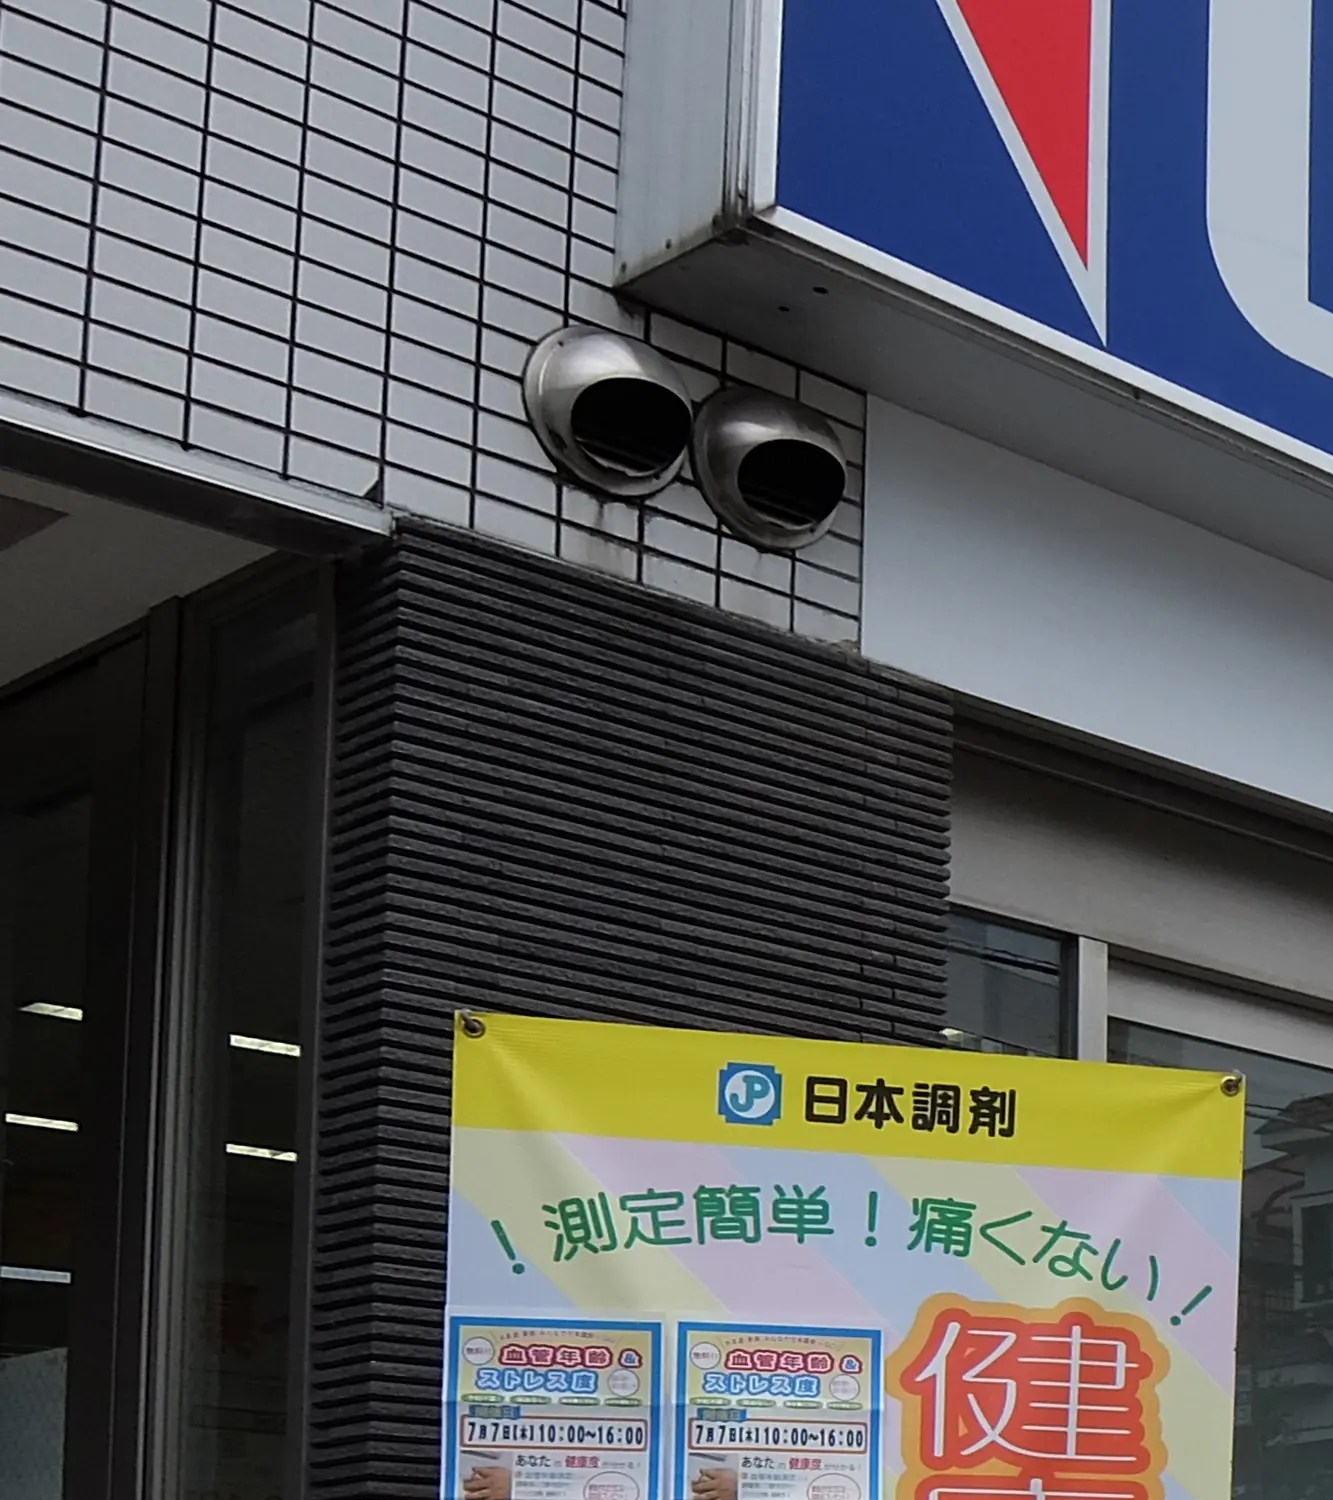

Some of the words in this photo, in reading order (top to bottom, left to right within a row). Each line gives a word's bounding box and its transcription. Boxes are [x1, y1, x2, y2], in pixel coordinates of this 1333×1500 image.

[803, 1076, 1018, 1138] 日本調剤
[725, 1349, 834, 1373] 血管年齢
[475, 1368, 598, 1393] ストレス度
[703, 1372, 820, 1397] ストレス度
